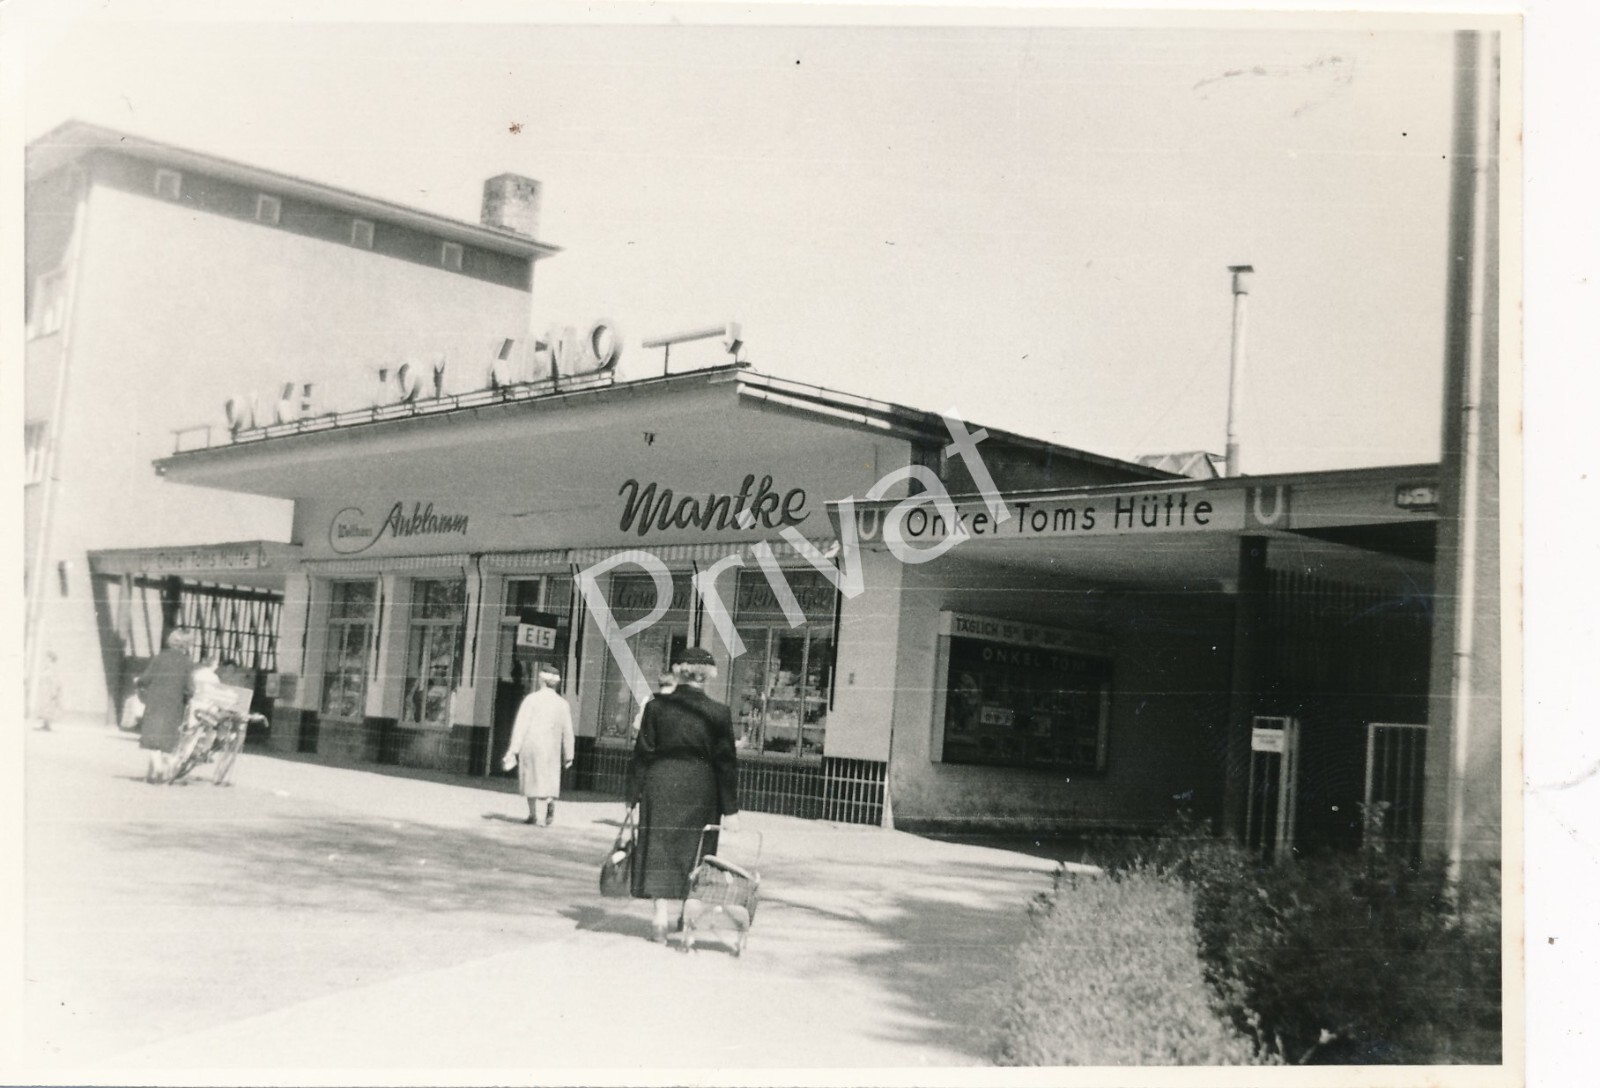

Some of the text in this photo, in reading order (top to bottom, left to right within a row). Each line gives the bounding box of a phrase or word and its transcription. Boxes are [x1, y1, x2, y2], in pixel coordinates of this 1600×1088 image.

[618, 475, 811, 536] Mantke
[907, 503, 999, 537] Onkel
[1015, 503, 1096, 532] Toms
[1113, 493, 1213, 528] Hütte
[1253, 487, 1284, 525] U
[956, 617, 999, 635] TÄGLICH
[525, 627, 551, 647] EIS
[982, 647, 1041, 668] ONKEL
